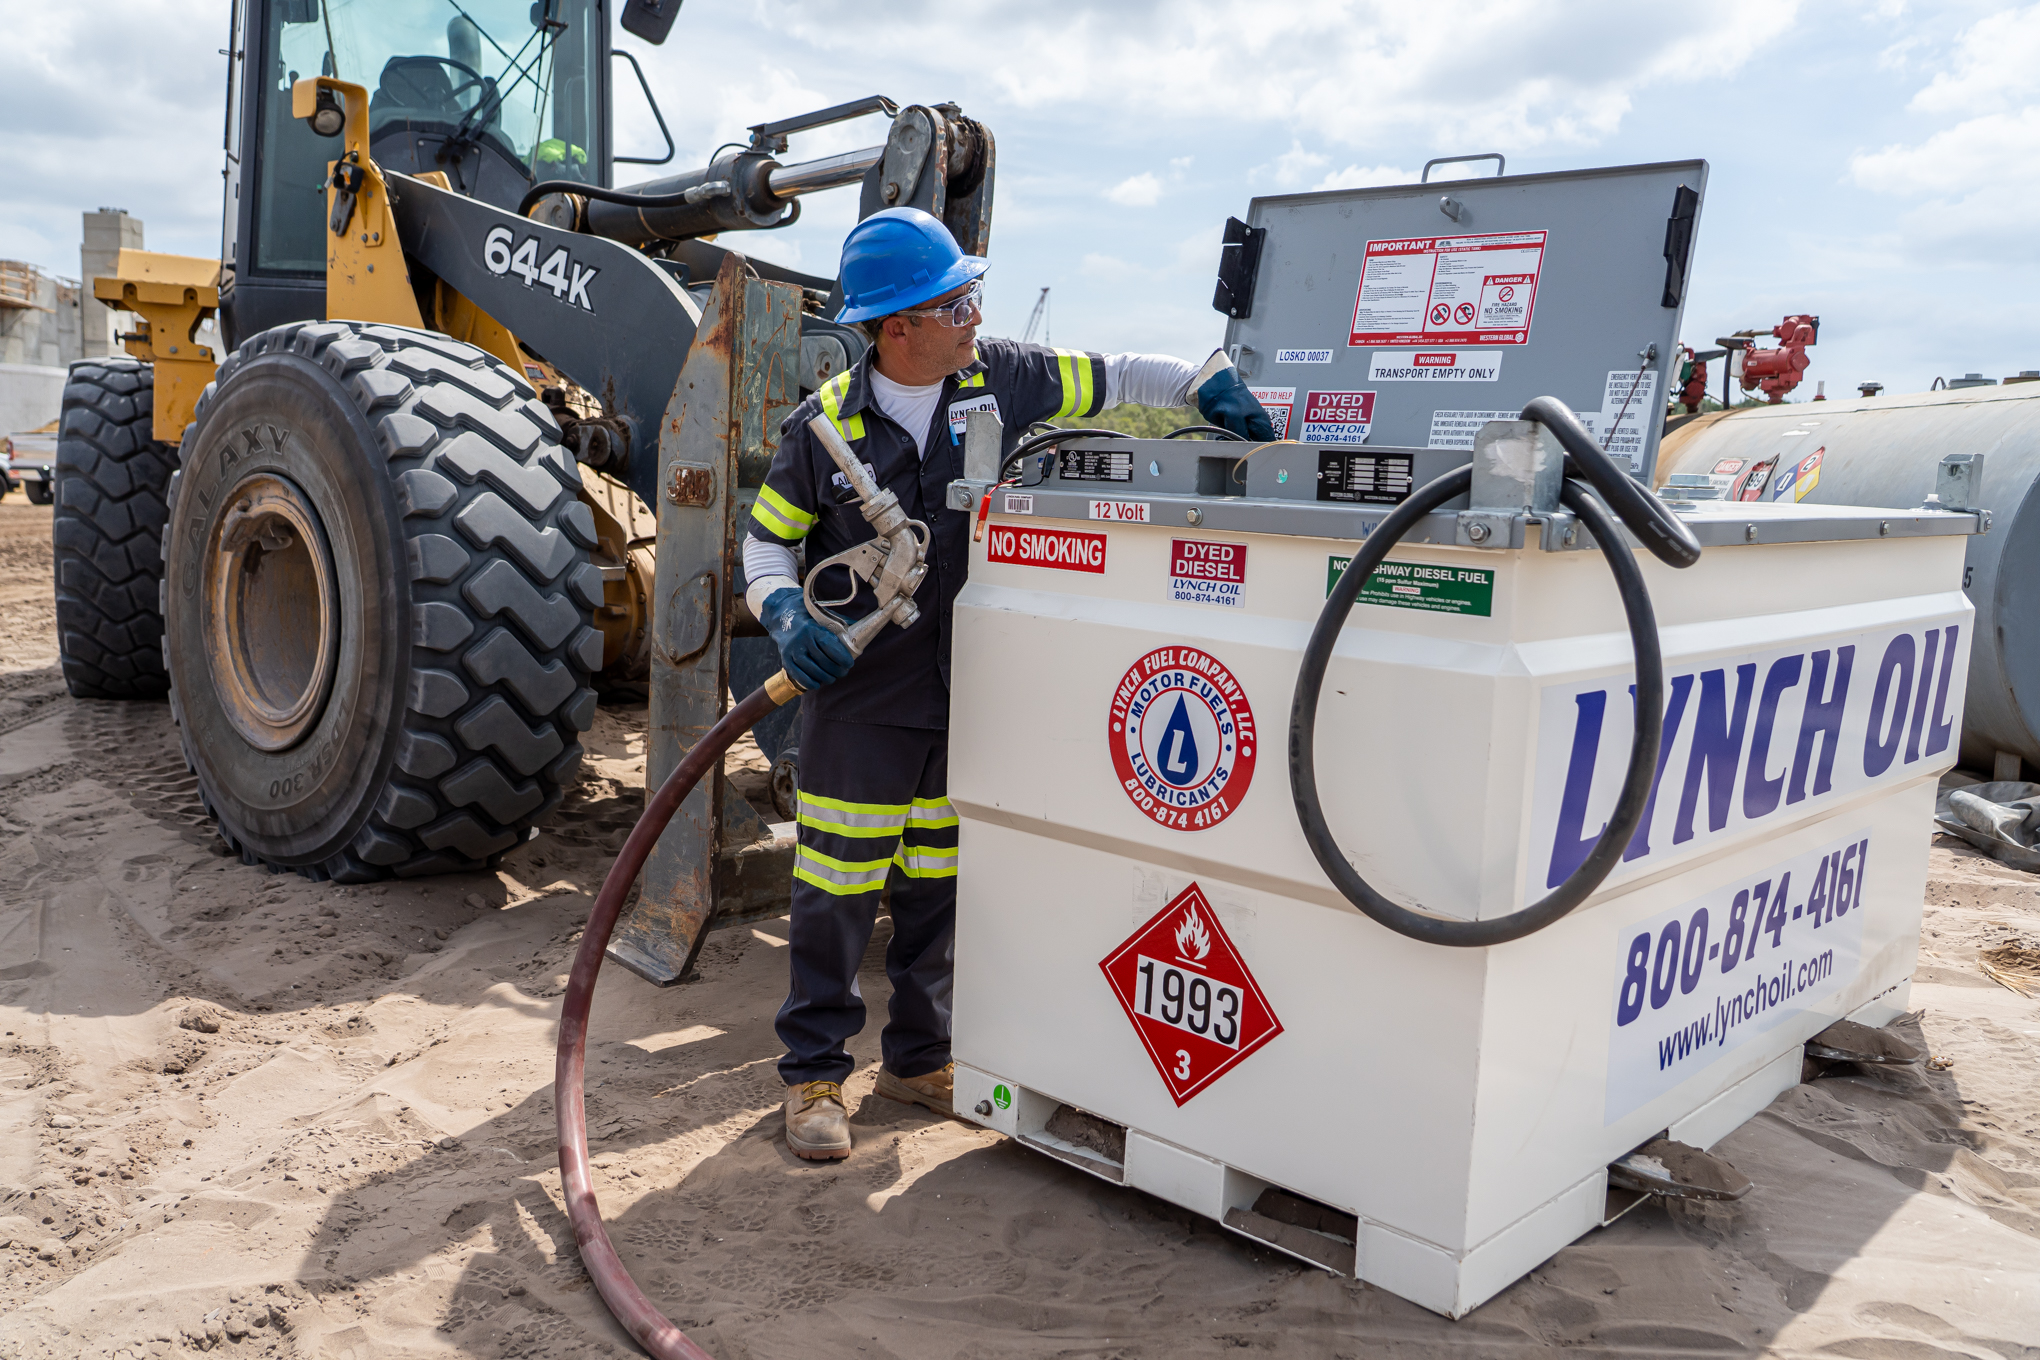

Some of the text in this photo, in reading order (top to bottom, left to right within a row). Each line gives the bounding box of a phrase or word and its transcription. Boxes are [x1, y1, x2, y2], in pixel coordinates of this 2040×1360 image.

[1368, 240, 1432, 252] IMPORTANT
[484, 225, 598, 313] 644K
[1494, 276, 1523, 284] DANGER
[1494, 306, 1523, 314] SMOKING
[1279, 351, 1330, 361] LOSKD 00037
[1418, 356, 1452, 364] WARNING
[1374, 368, 1495, 378] TRANSPORT EMPTY ONLY
[1270, 391, 1278, 400] TO
[1278, 391, 1293, 400] HELP
[1318, 394, 1364, 407] DYED
[980, 402, 997, 412] OIL
[1309, 408, 1367, 421] DIESEL
[1305, 424, 1366, 434] LYNCH OIL
[1306, 434, 1361, 443] 800-874-4161
[1802, 456, 1816, 471] 2
[1780, 474, 1791, 489] 1
[182, 422, 291, 600] GALAXY
[1095, 502, 1144, 521] 12 Volt
[990, 531, 1103, 566] NO SMOKING
[1183, 543, 1234, 562] DYED
[1175, 561, 1240, 580] DIESEL
[1413, 567, 1455, 581] DIESEL
[1457, 573, 1489, 584] FUEL
[1173, 579, 1241, 595] LYNCH OIL
[1394, 586, 1420, 594] WARNING
[1412, 580, 1439, 589] Maximum)
[1174, 591, 1236, 606] 800-874-4161
[1378, 598, 1397, 606] damage
[1405, 594, 1425, 603] Highway
[1112, 668, 1143, 720] LYNCH
[1143, 649, 1176, 675] FUEL
[1235, 711, 1254, 741] LLC
[1130, 672, 1233, 735] MOTOR FUELS
[1166, 729, 1188, 774] L
[1546, 624, 1960, 890] LYNCH OIL
[1130, 751, 1229, 806] LUBRICANTS
[1194, 796, 1230, 827] 4161
[1616, 838, 1869, 1027] 800-874-4161
[1138, 961, 1239, 1045] 1993
[1658, 948, 1833, 1072] www.lynchoil.com
[1173, 1049, 1191, 1081] 3
